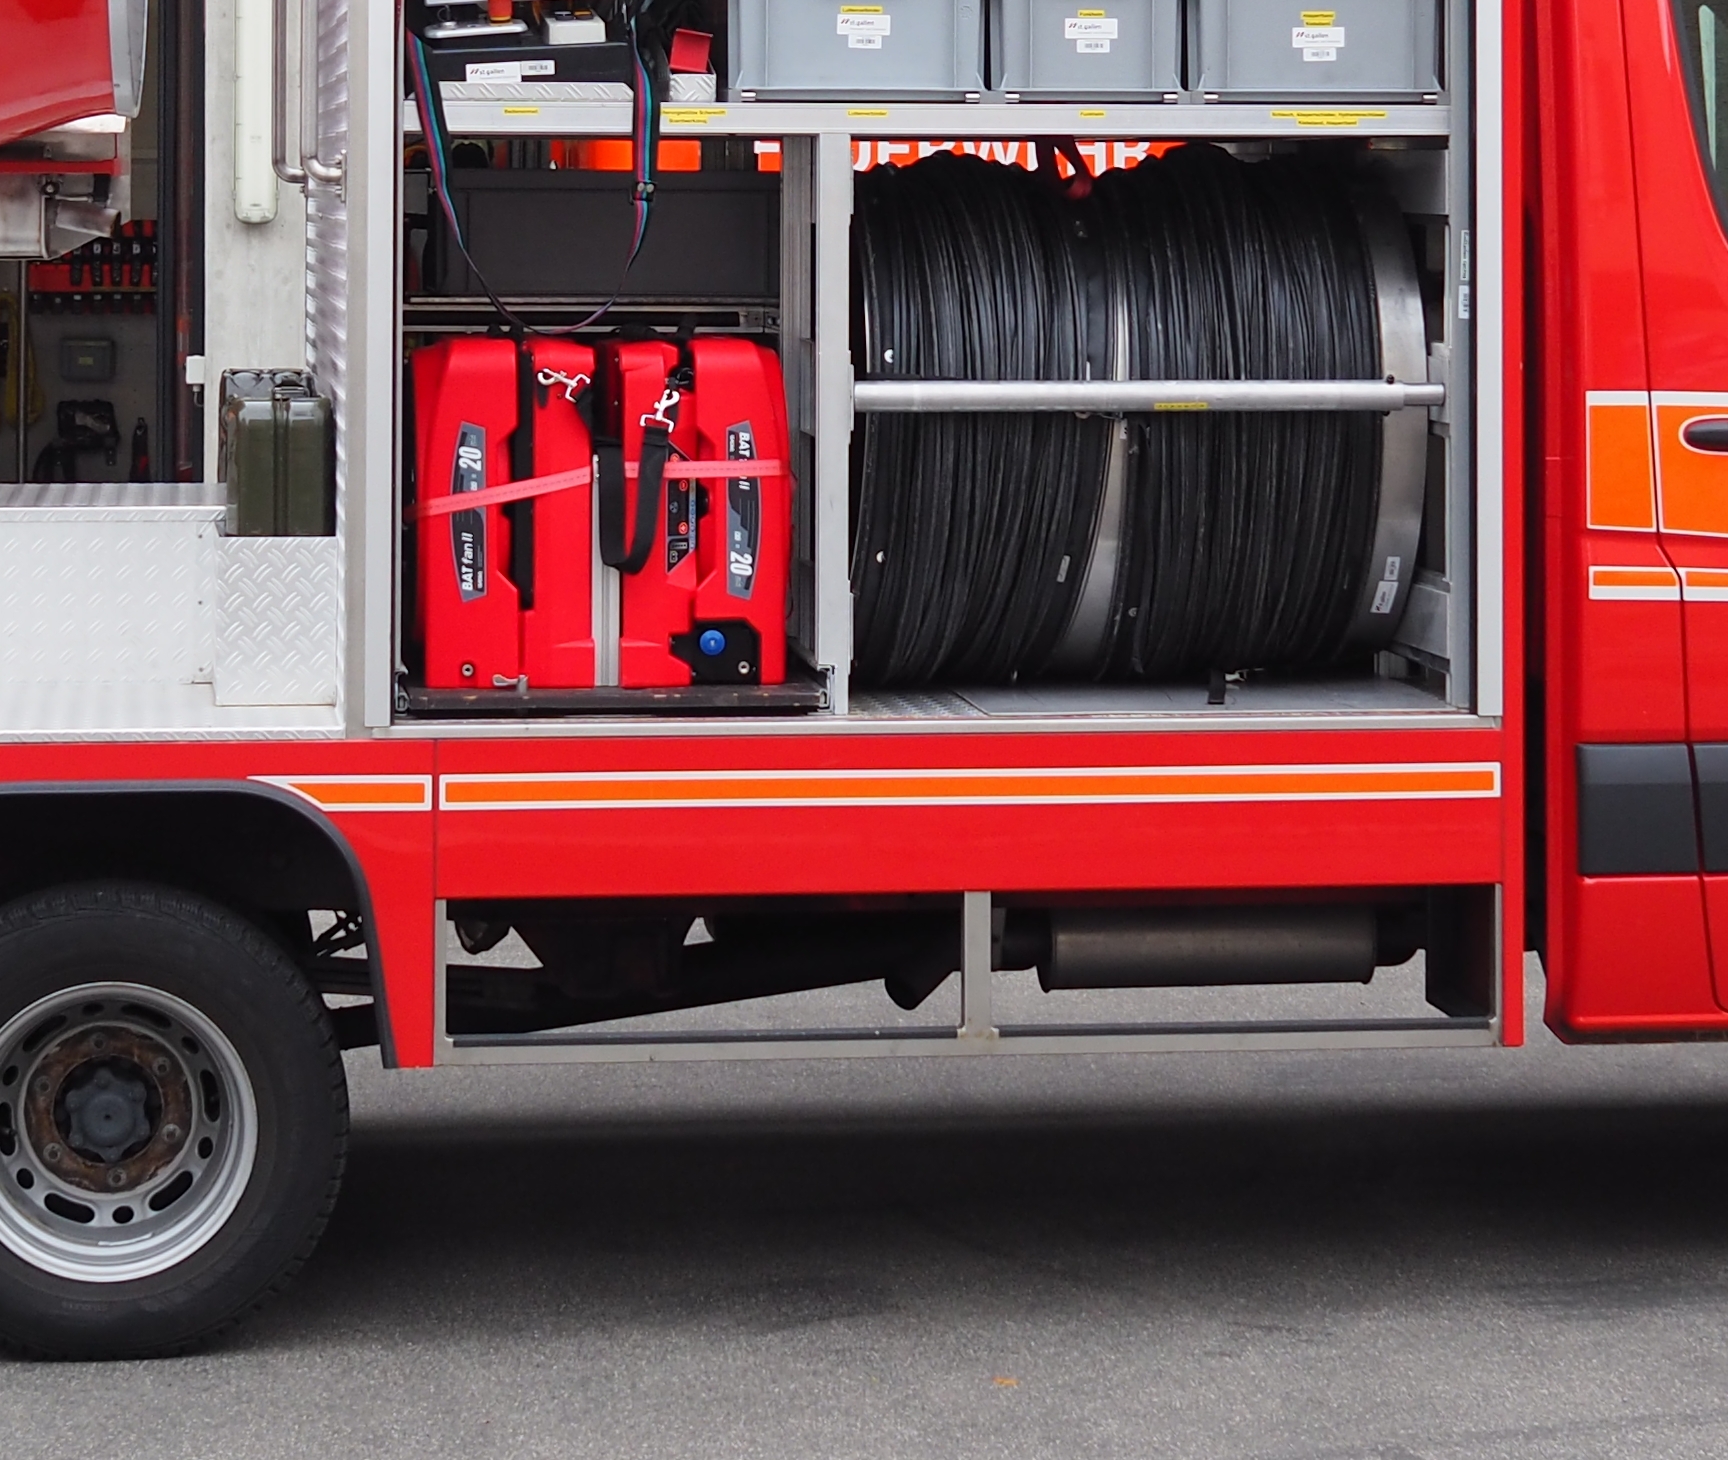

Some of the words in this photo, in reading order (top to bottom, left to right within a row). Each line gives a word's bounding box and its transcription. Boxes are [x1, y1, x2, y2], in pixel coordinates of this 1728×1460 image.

[739, 431, 751, 457] BAT
[458, 445, 482, 472] 20
[461, 543, 474, 566] fan
[730, 551, 753, 577] 20
[461, 566, 474, 591] BAT
